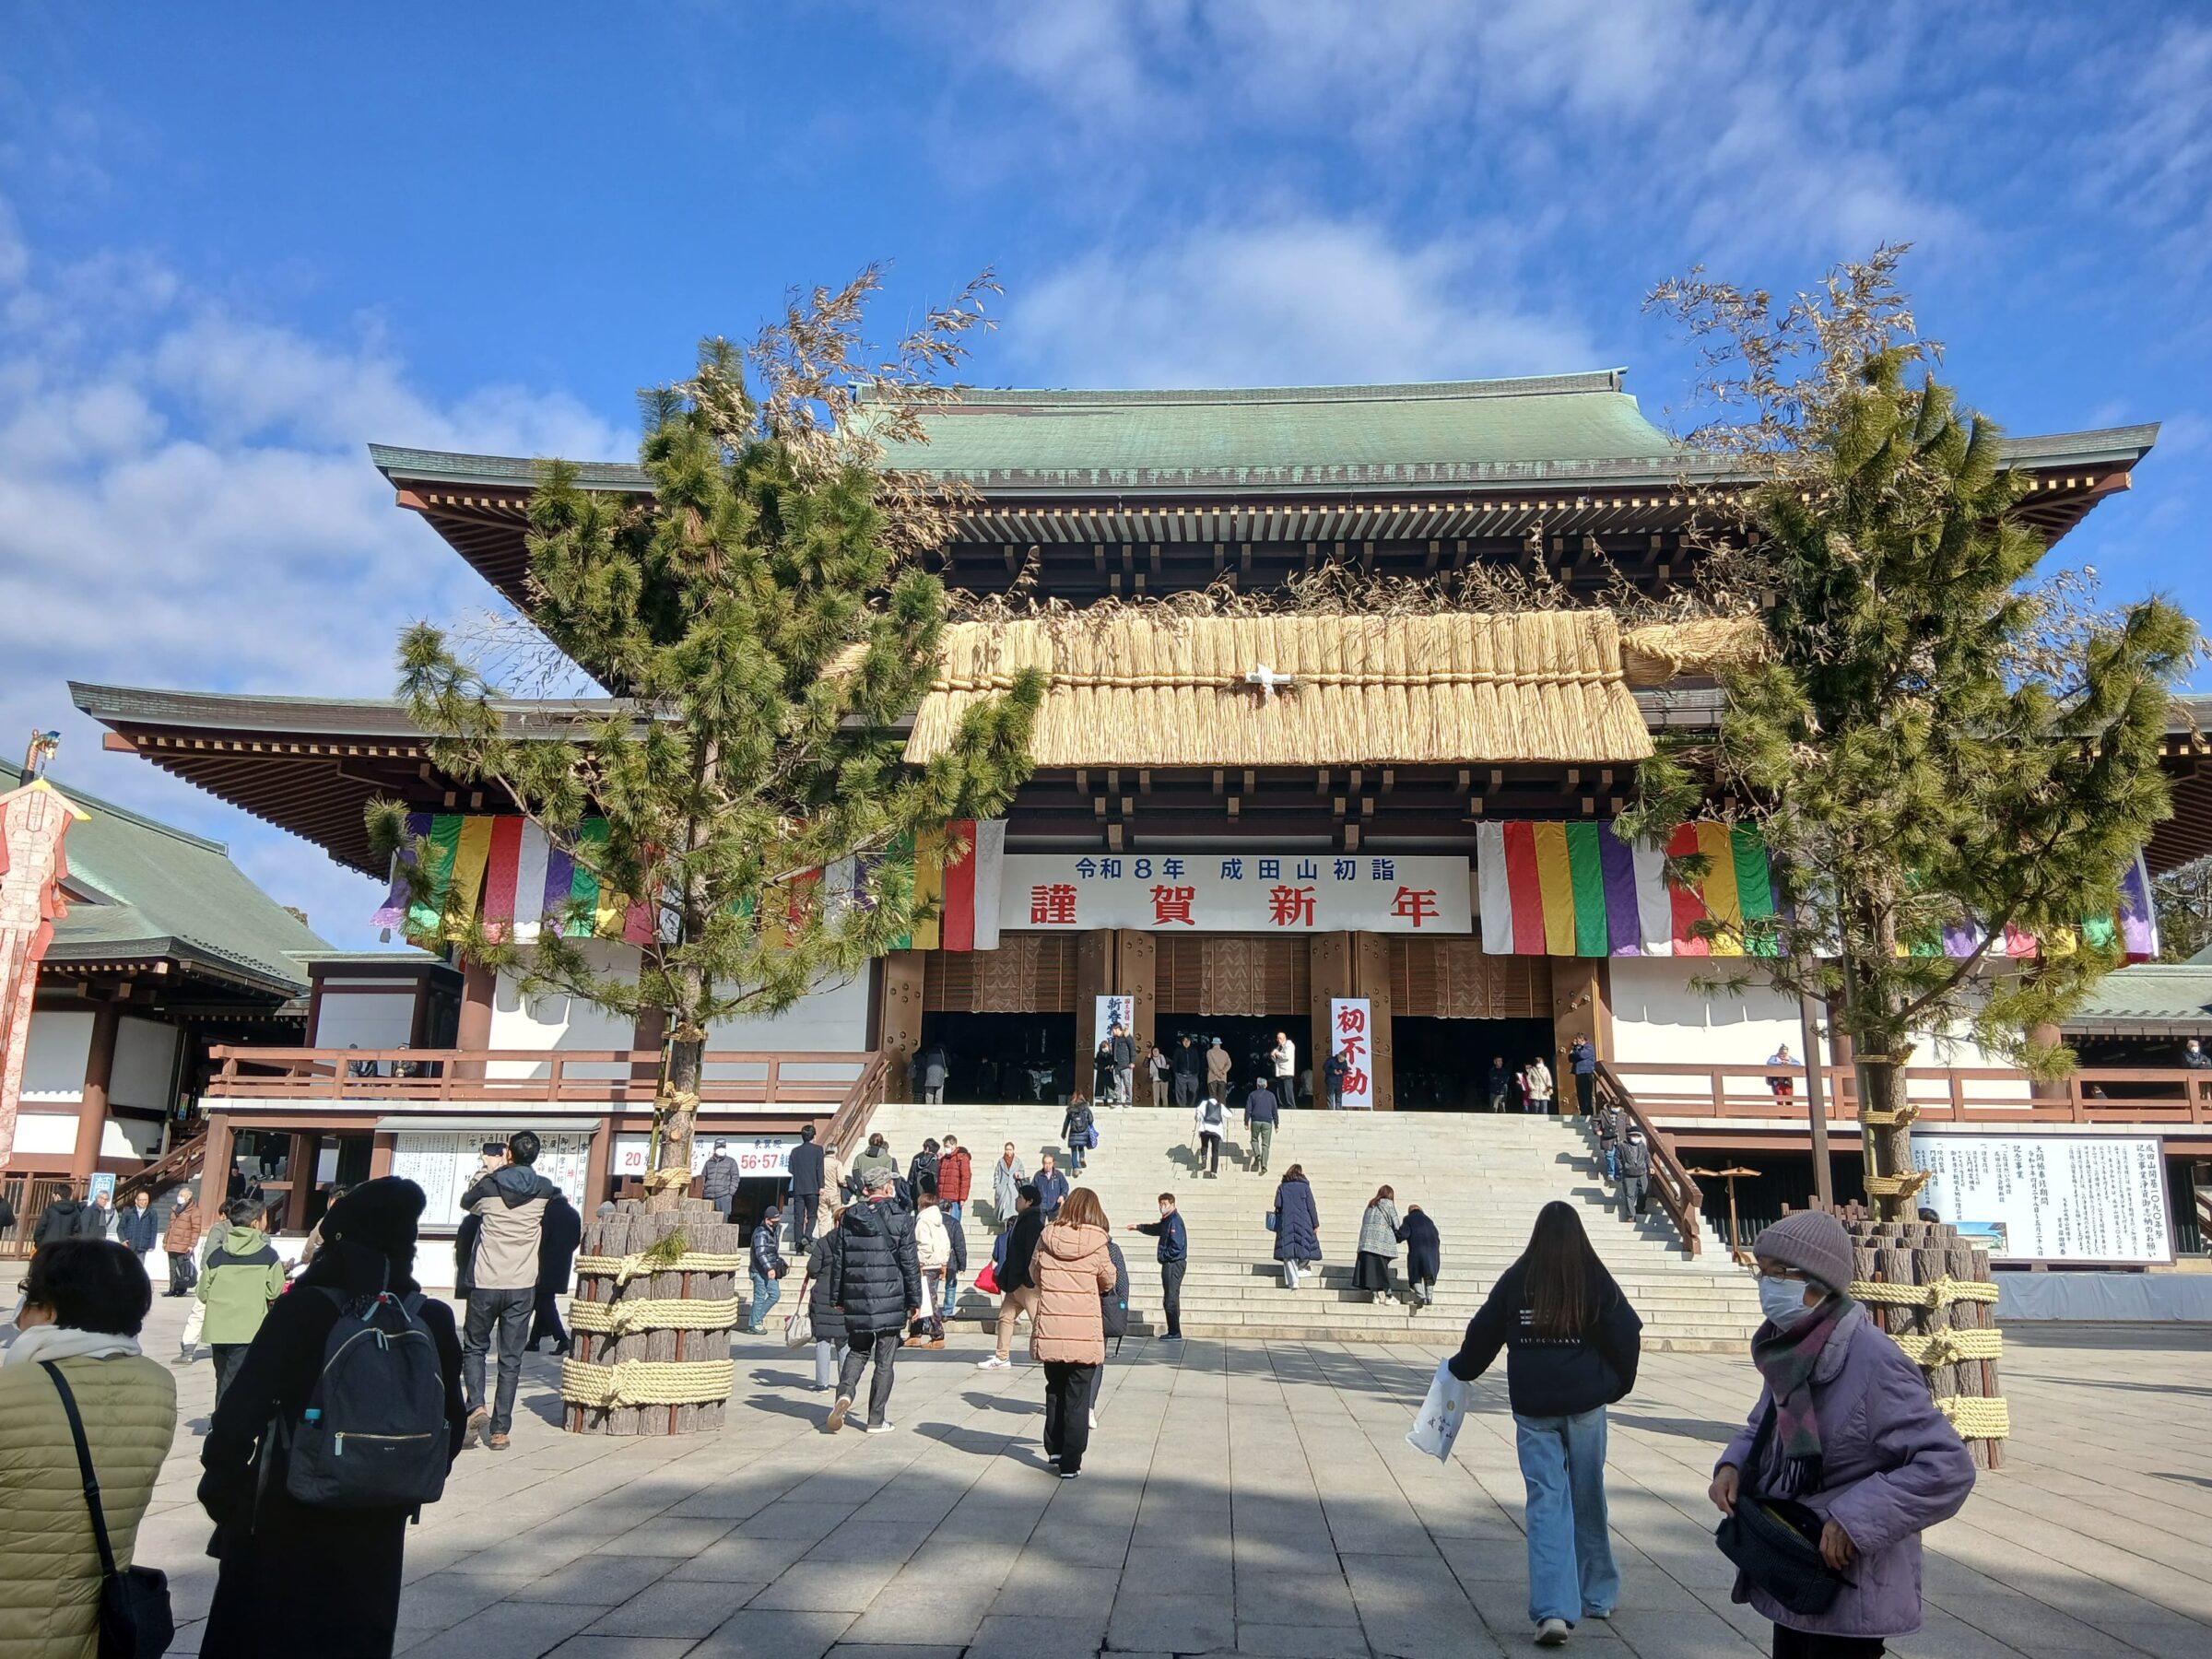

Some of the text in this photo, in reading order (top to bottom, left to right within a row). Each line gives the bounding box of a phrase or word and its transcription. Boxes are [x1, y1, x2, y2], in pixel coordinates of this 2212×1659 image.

[1076, 857, 1394, 881] 令和8年 成田山初詣
[1030, 884, 1440, 928] 謹賀新年
[1335, 1006, 1368, 1096] 初不動
